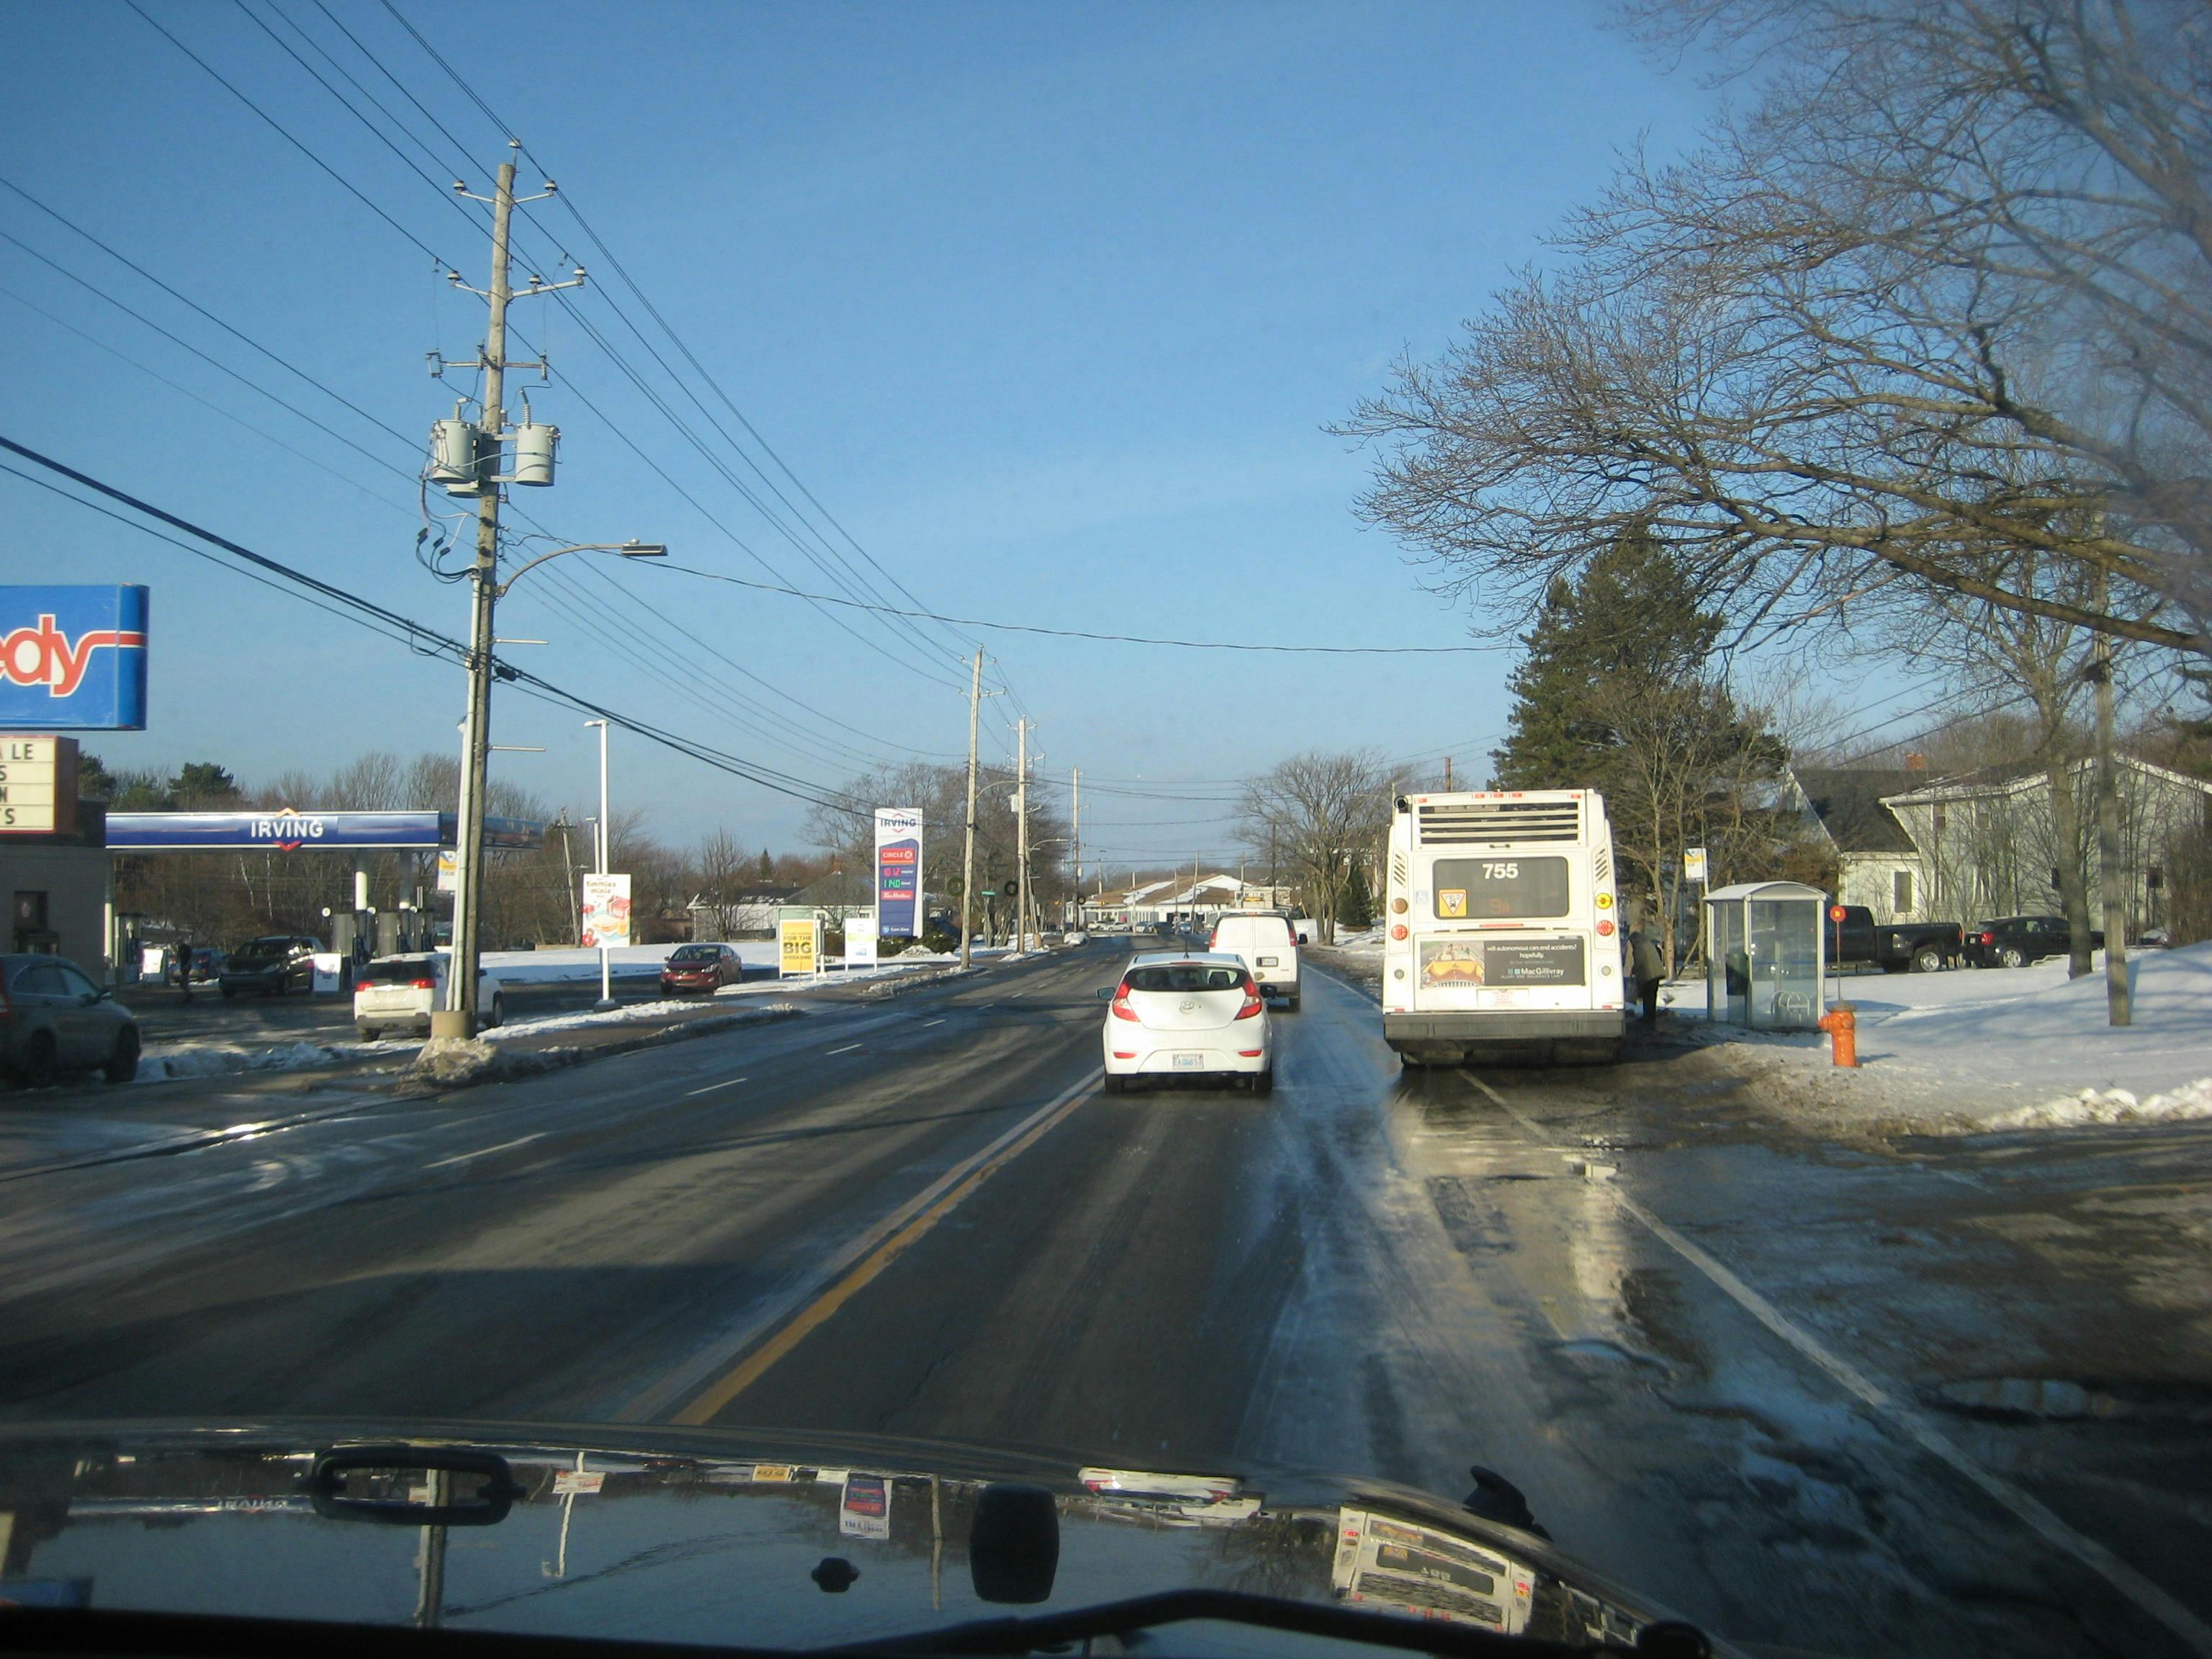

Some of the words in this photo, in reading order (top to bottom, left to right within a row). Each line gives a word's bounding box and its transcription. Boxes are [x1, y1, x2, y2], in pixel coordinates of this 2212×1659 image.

[880, 818, 917, 827] IRVING
[251, 820, 324, 837] IRVING
[1482, 863, 1518, 879] 755
[783, 942, 811, 953] BIG
[1521, 968, 1564, 976] MacGillivray
